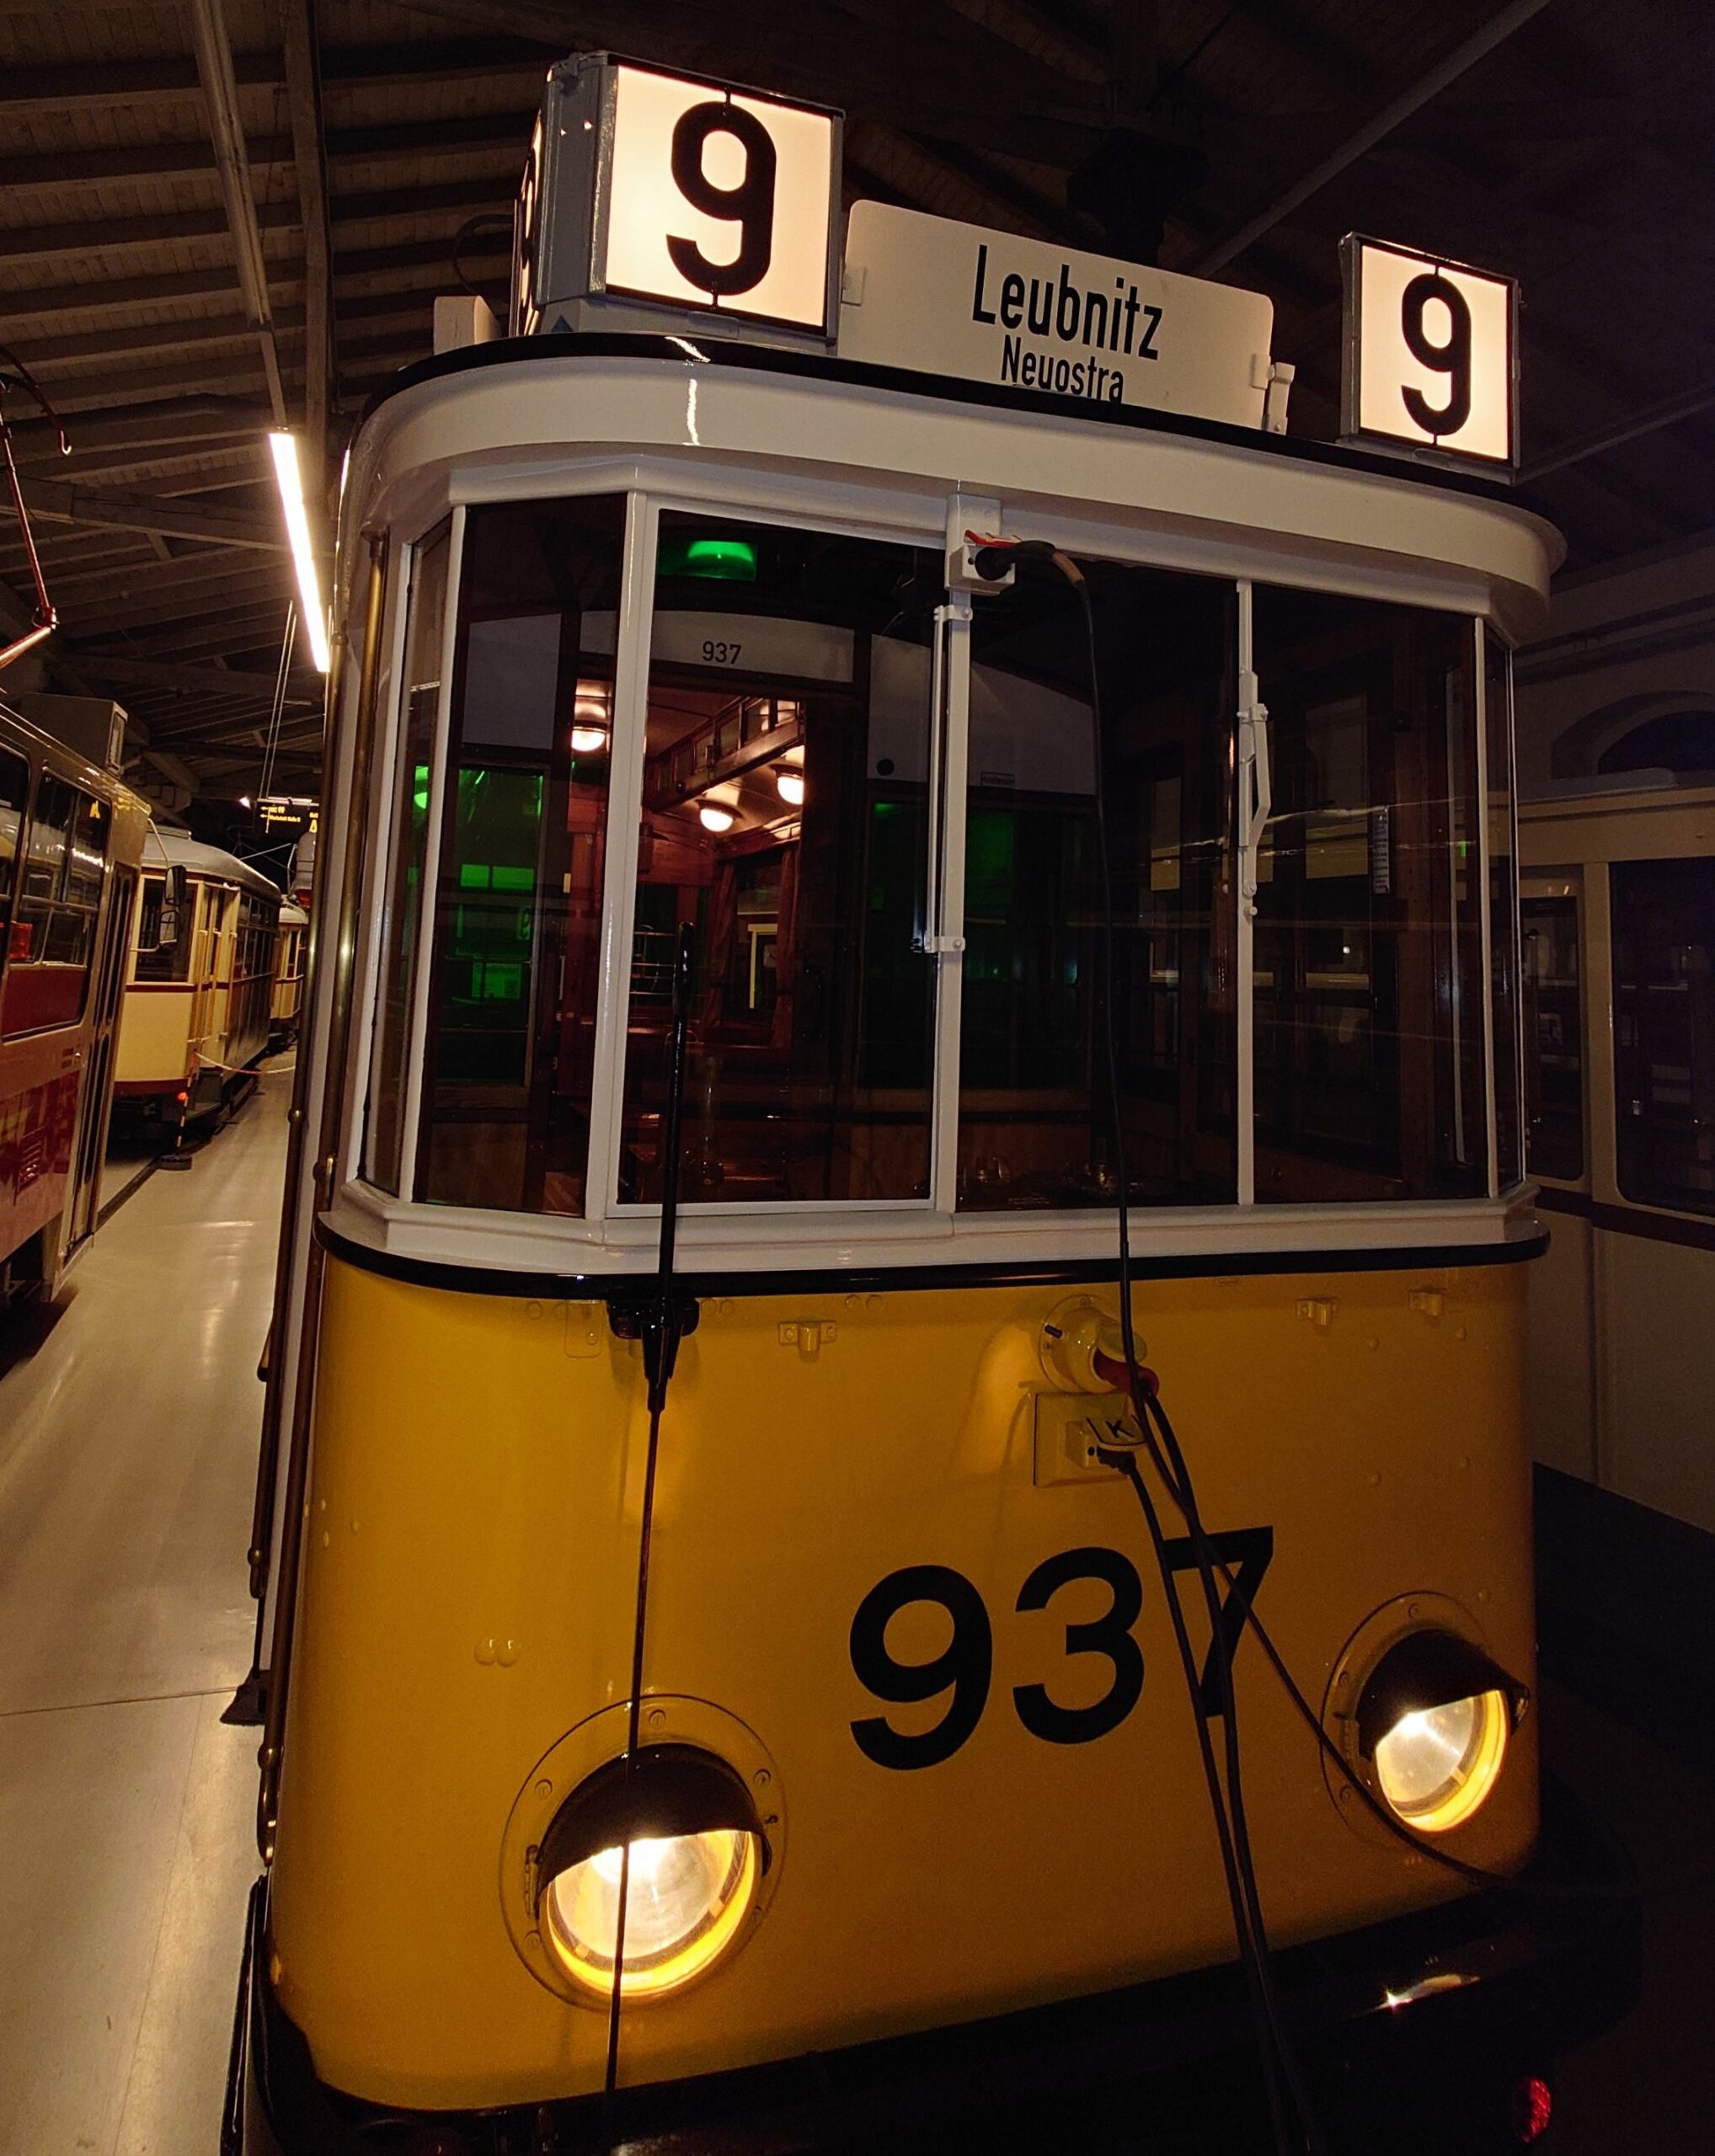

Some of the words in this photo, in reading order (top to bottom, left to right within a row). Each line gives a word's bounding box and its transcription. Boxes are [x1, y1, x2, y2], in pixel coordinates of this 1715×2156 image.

[665, 100, 777, 296] 9
[972, 243, 1163, 360] Leubnitz
[1001, 334, 1124, 404] Neuostra
[1402, 272, 1472, 436] 9
[702, 640, 741, 664] 937
[849, 1525, 1274, 1770] 937
